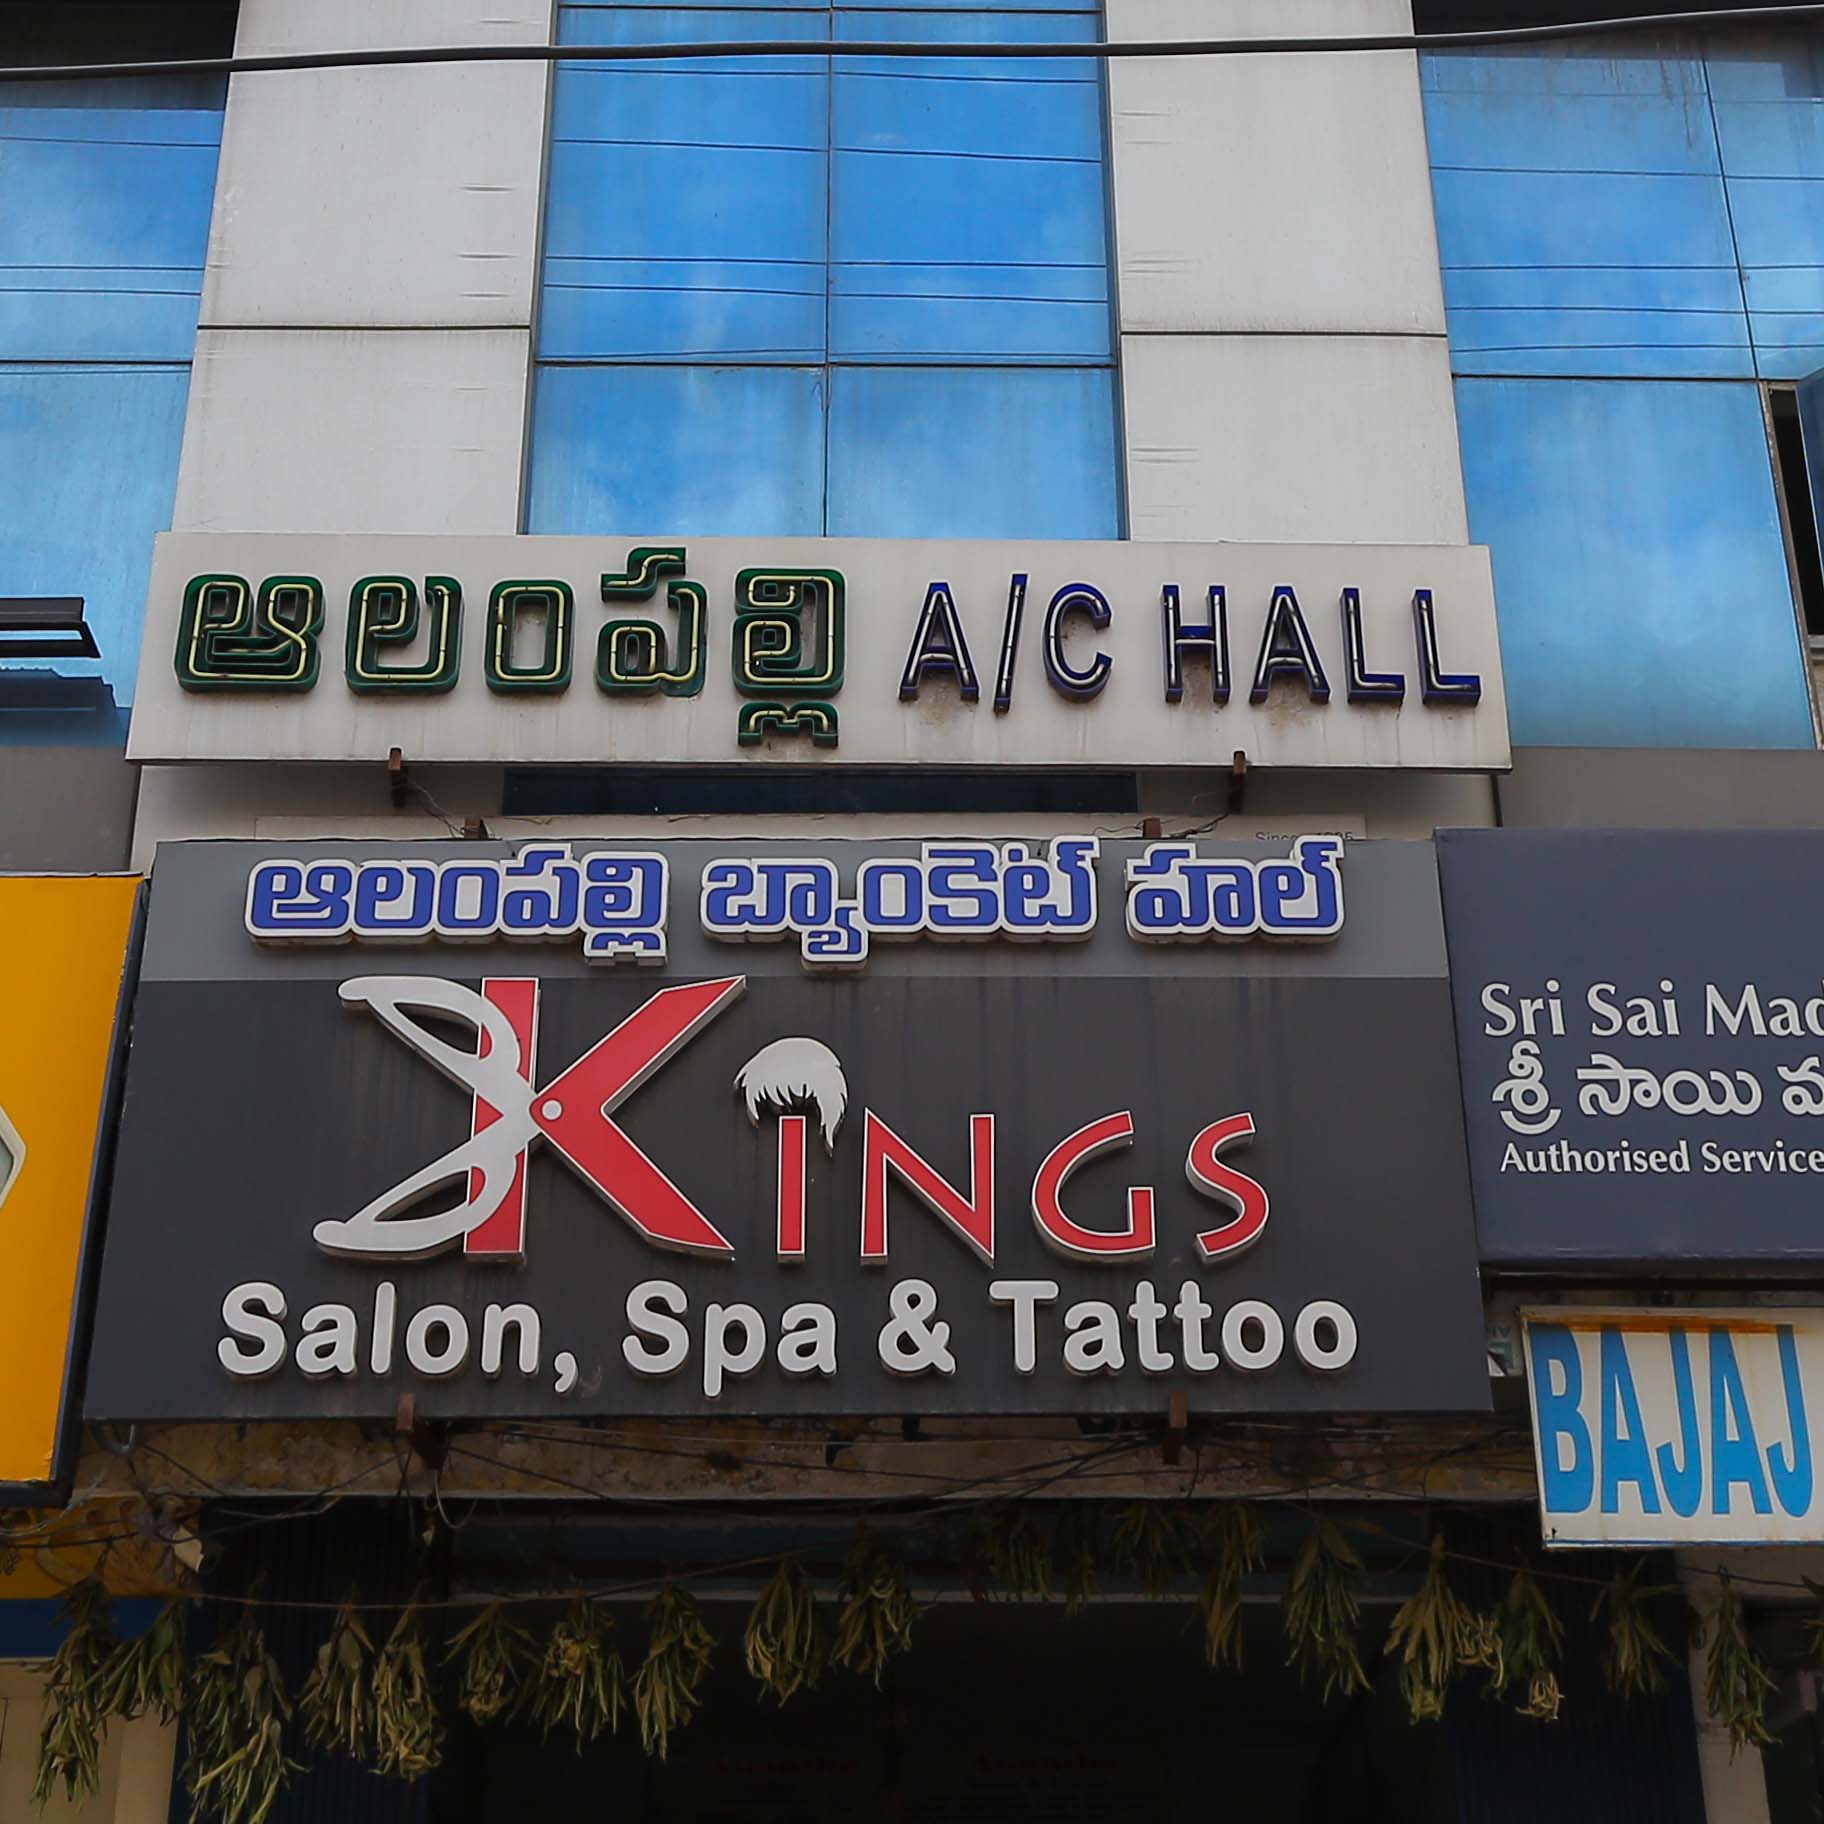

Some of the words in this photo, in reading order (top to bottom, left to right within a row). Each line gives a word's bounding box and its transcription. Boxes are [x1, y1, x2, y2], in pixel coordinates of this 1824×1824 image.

[898, 571, 1112, 714] A/C
[1161, 584, 1483, 708] HALL
[1480, 978, 1567, 1039] Sri
[1585, 978, 1680, 1039] Sai
[1499, 1139, 1691, 1176] Authorised
[216, 1279, 578, 1394] Salon,
[622, 1278, 839, 1396] Spa
[876, 1277, 957, 1375] &
[988, 1278, 1360, 1375] Tattoo
[1529, 1319, 1813, 1521] BAJAJ
